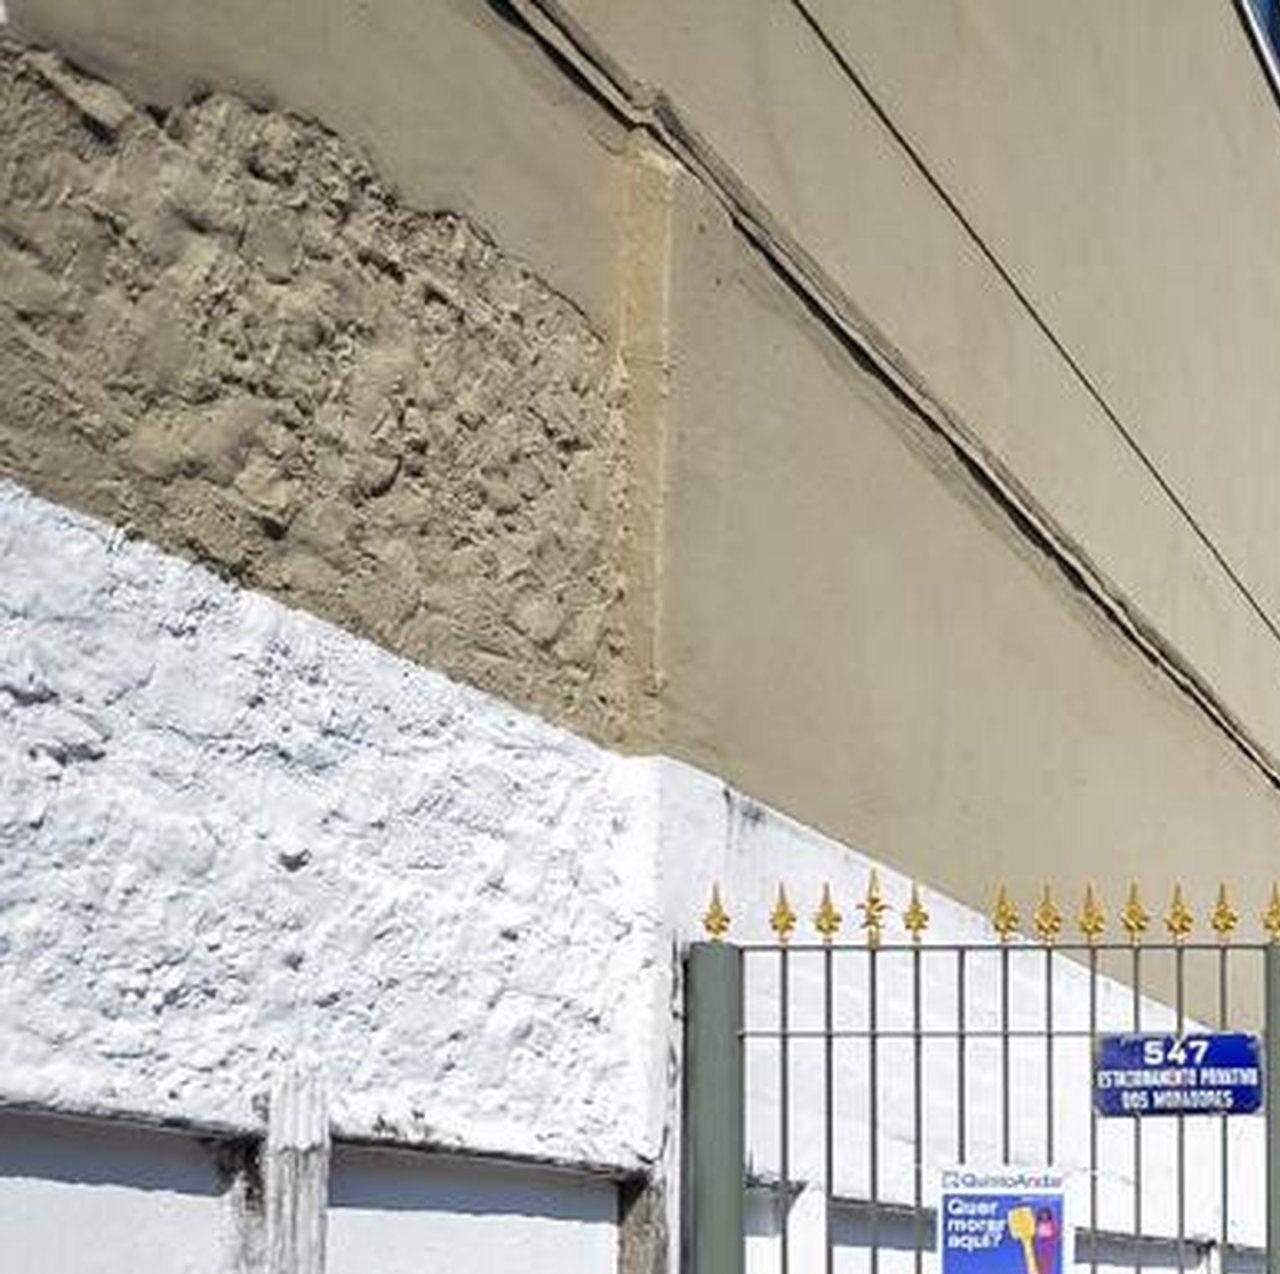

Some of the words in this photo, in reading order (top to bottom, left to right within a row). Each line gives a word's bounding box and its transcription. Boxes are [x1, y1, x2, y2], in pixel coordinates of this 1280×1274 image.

[1144, 1040, 1209, 1065] 547
[947, 1199, 999, 1215] Quer
[947, 1233, 1003, 1252] aqui?
